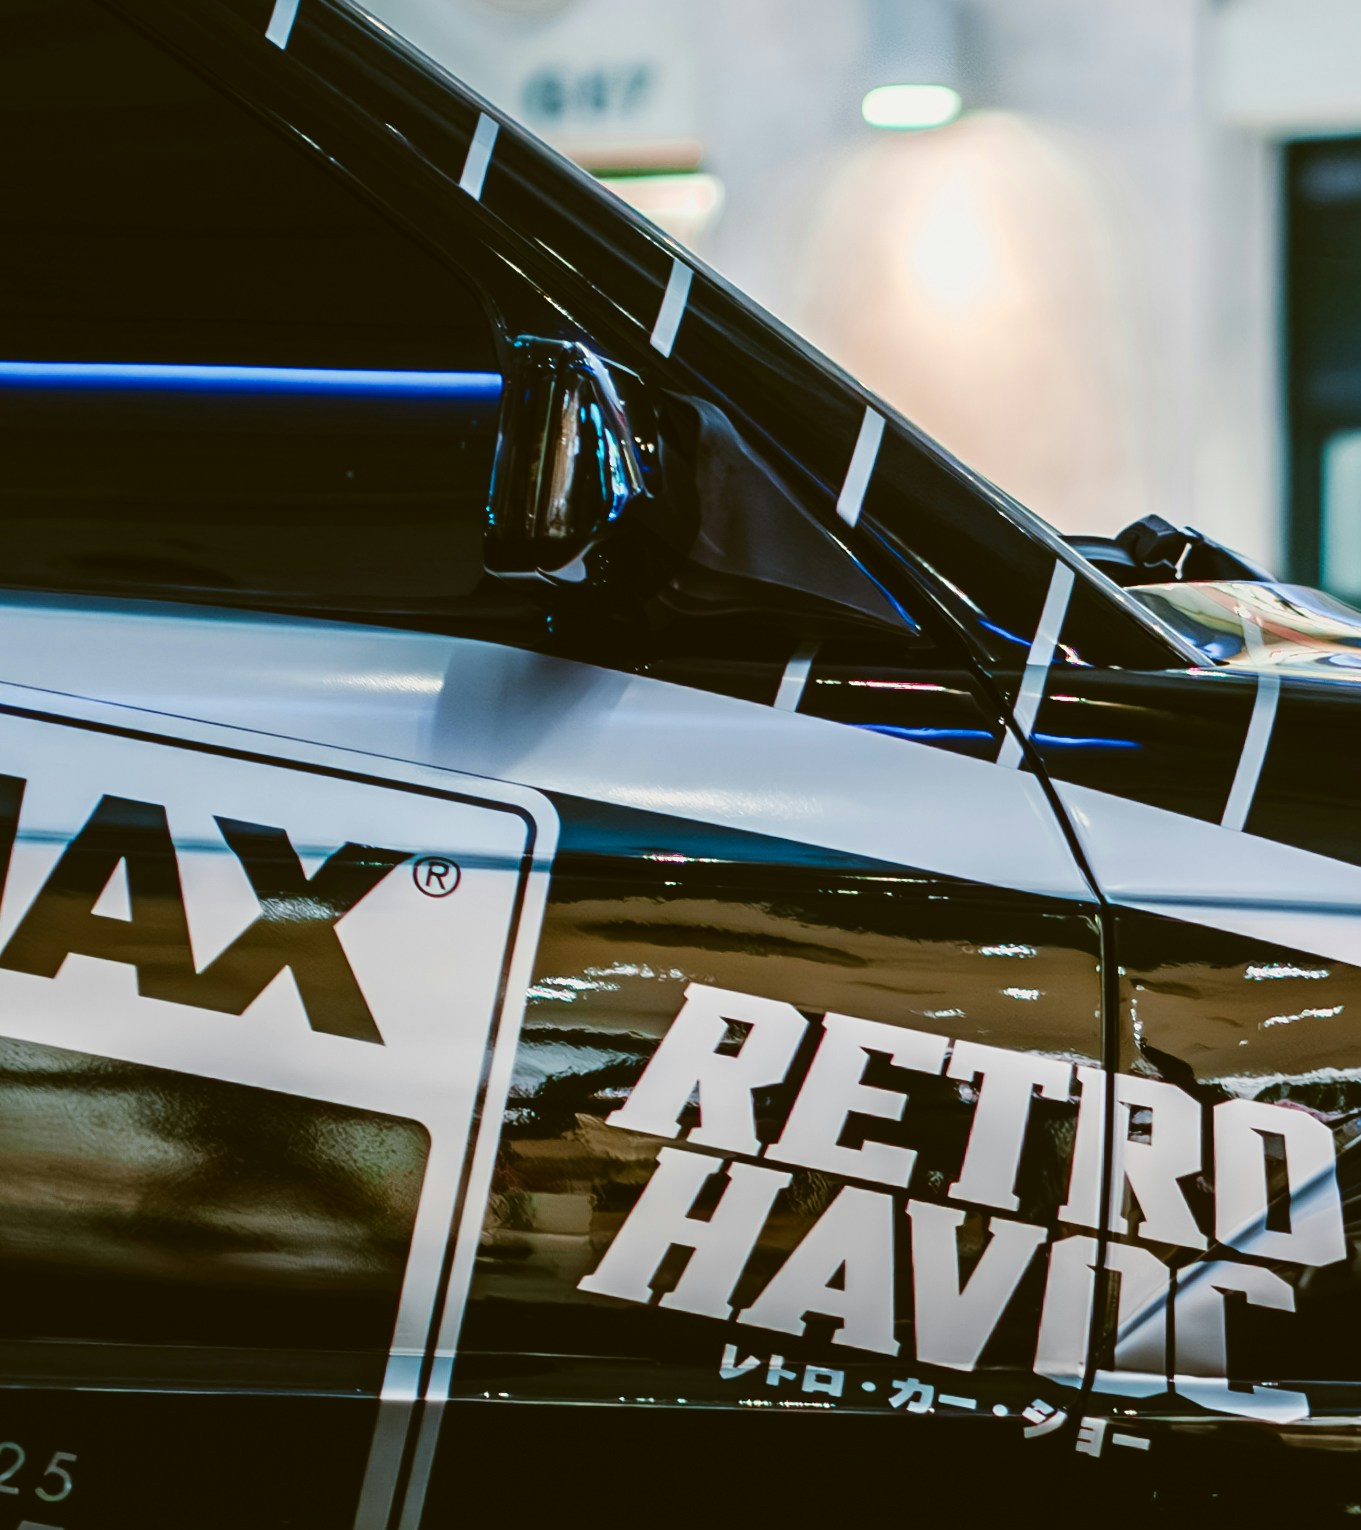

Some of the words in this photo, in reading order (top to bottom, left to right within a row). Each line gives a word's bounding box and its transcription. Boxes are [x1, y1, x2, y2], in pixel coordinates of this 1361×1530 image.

[605, 982, 1347, 1267] RETRO
[576, 1146, 1310, 1422] HAVOC
[719, 1344, 1151, 1458] レトロ・カー・ショー
